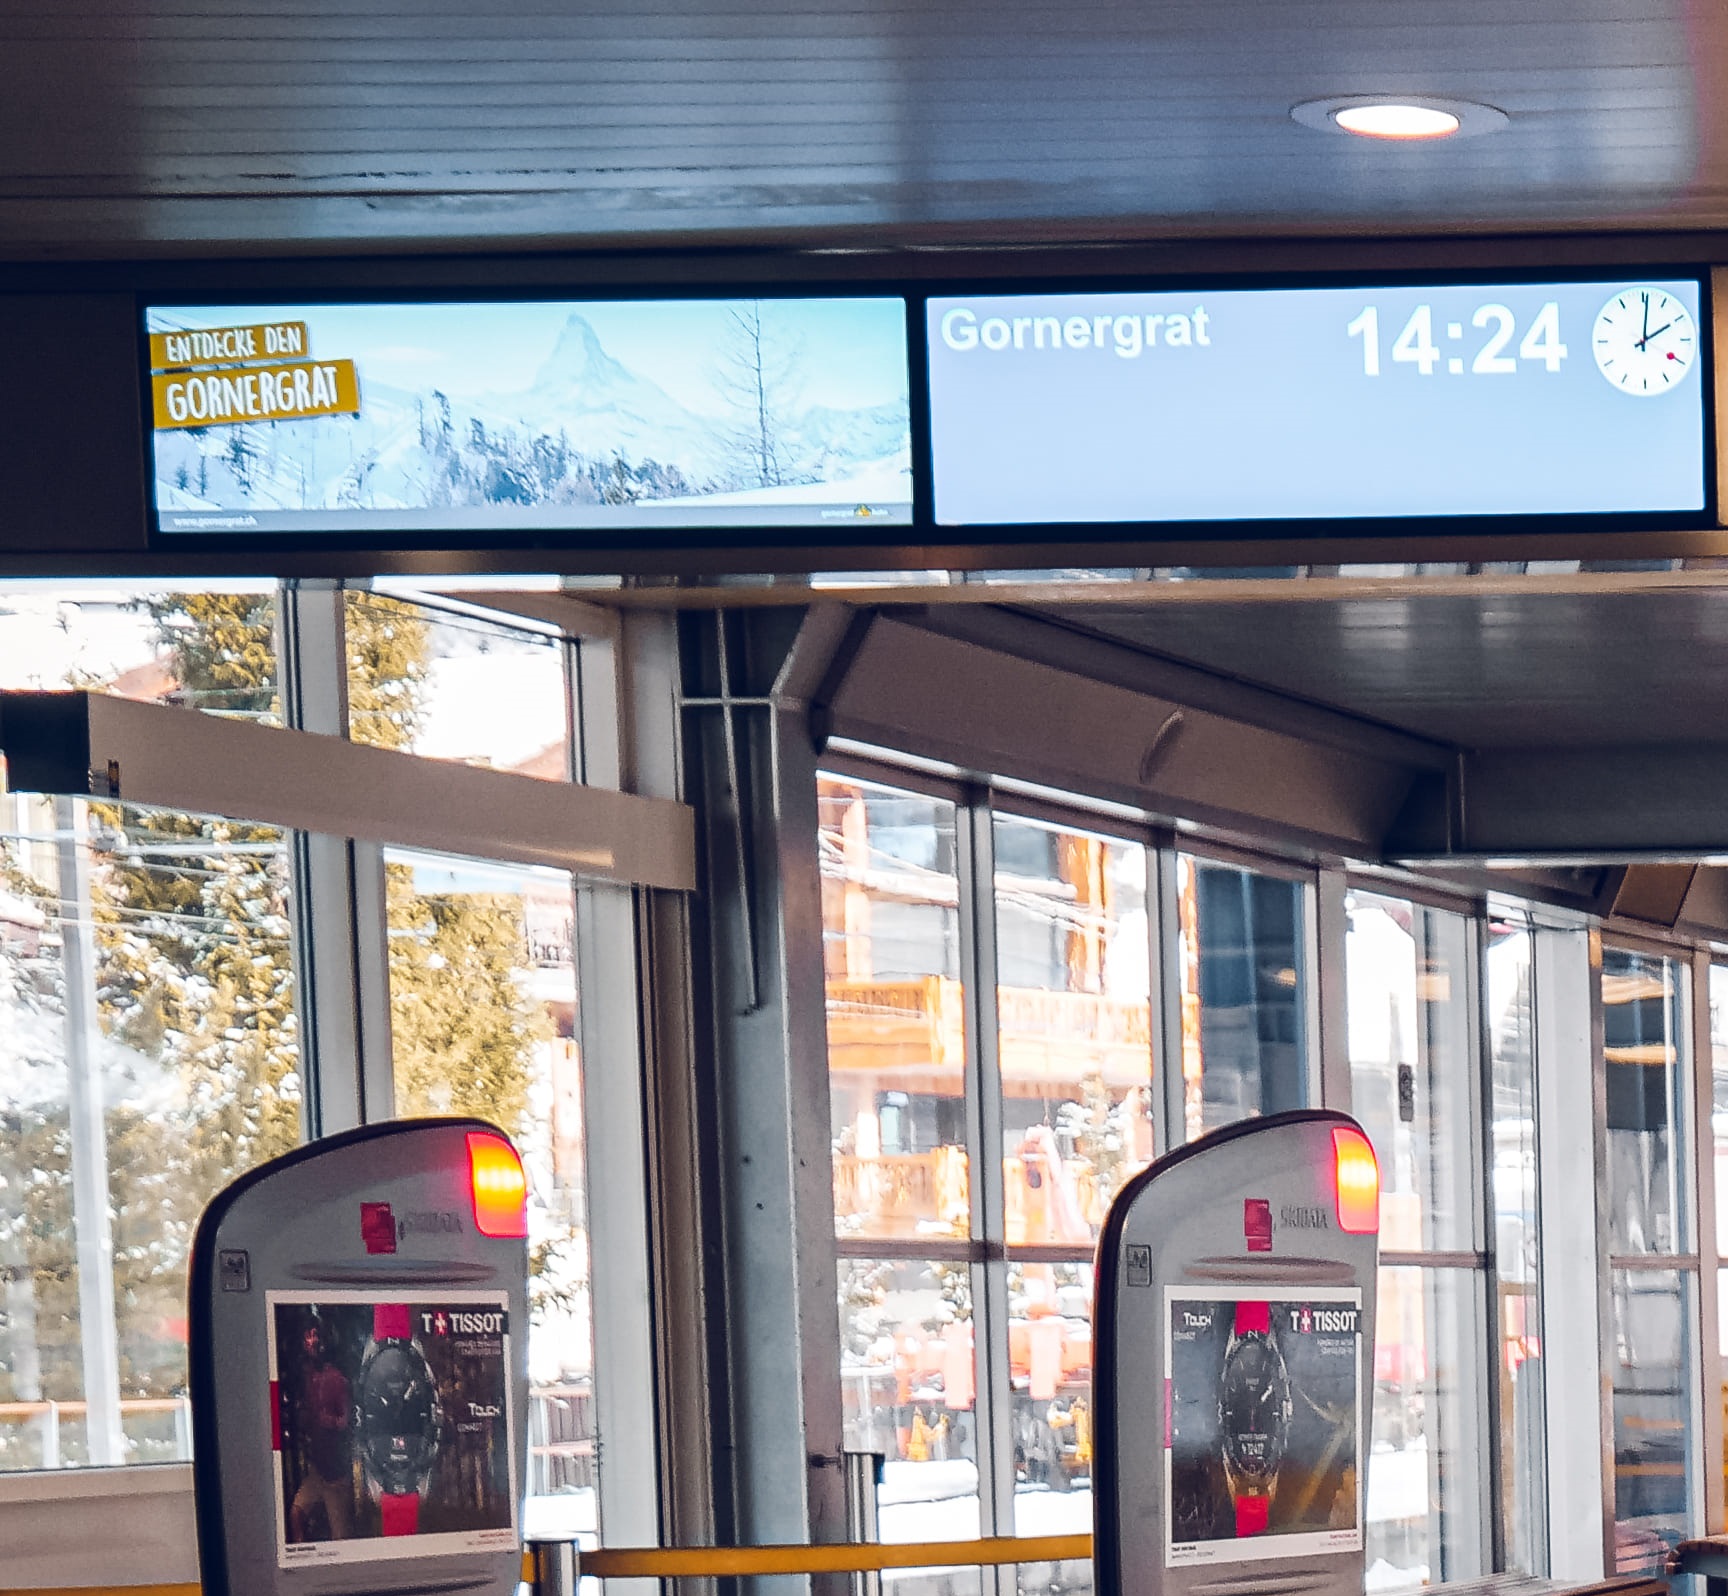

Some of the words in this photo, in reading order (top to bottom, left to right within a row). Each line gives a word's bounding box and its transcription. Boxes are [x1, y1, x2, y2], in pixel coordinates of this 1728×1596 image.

[165, 328, 258, 363] ENTDECKE
[264, 325, 303, 355] DEN
[940, 304, 1212, 358] Gornergrat
[1346, 301, 1568, 377] 14:24
[166, 365, 338, 422] GORNERGRAT
[448, 1312, 504, 1334] TISSOT
[1315, 1310, 1358, 1332] TISSOT
